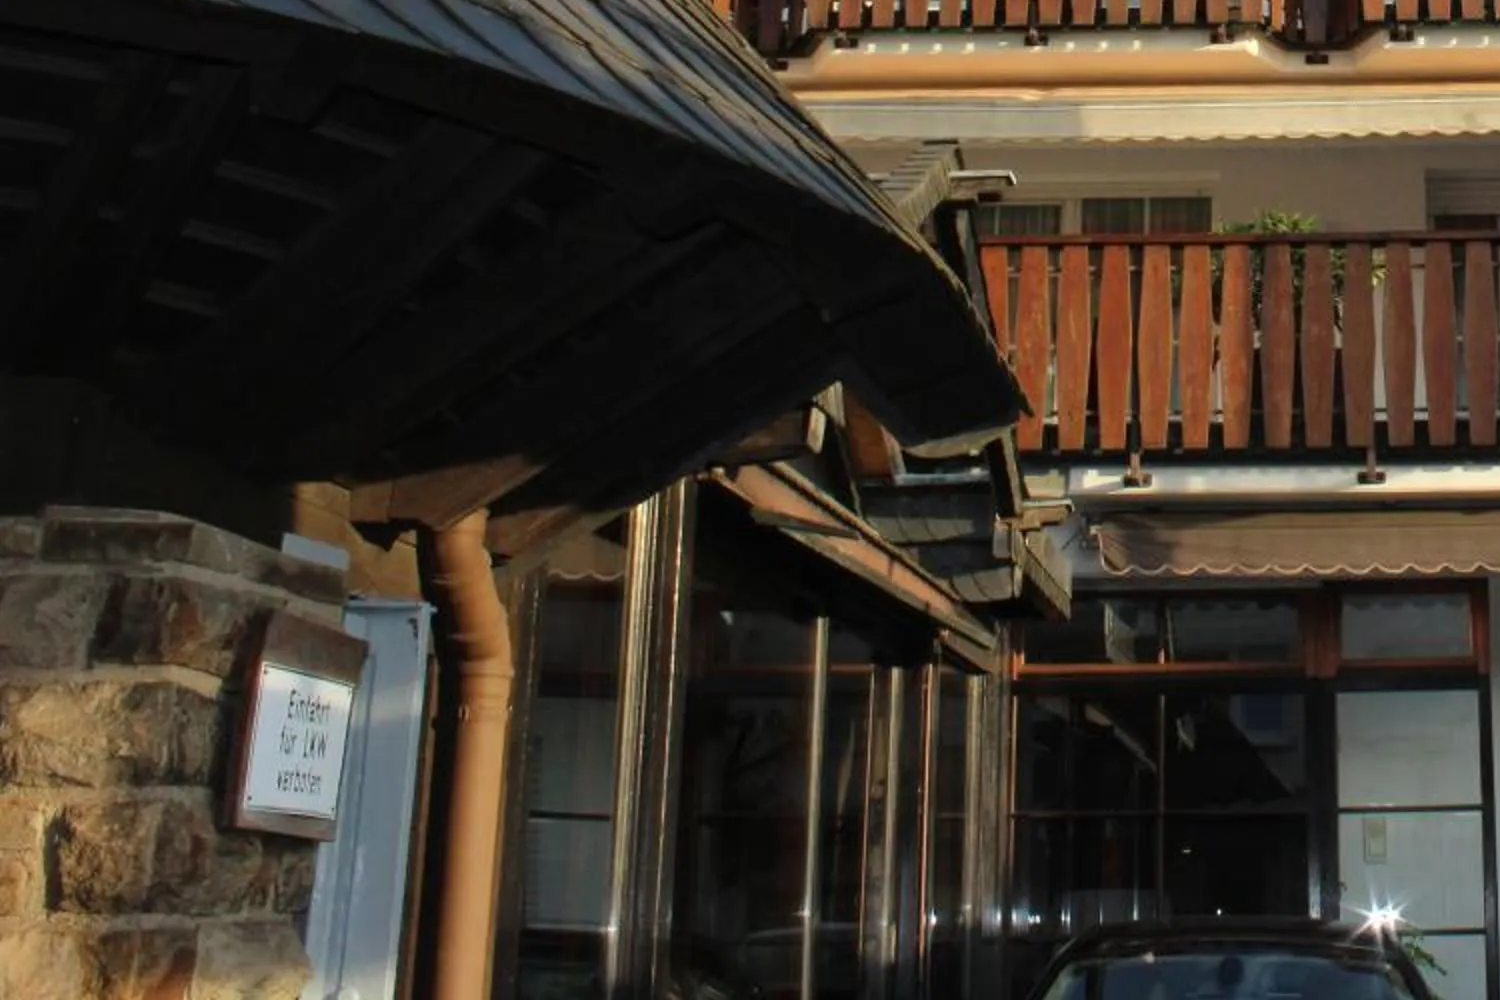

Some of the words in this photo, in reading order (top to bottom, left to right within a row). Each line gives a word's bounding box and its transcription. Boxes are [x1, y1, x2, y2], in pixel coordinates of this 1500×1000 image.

[286, 688, 330, 724] Einfahrt
[280, 723, 297, 755] für
[303, 727, 330, 760] LKW
[276, 764, 322, 796] verboten
